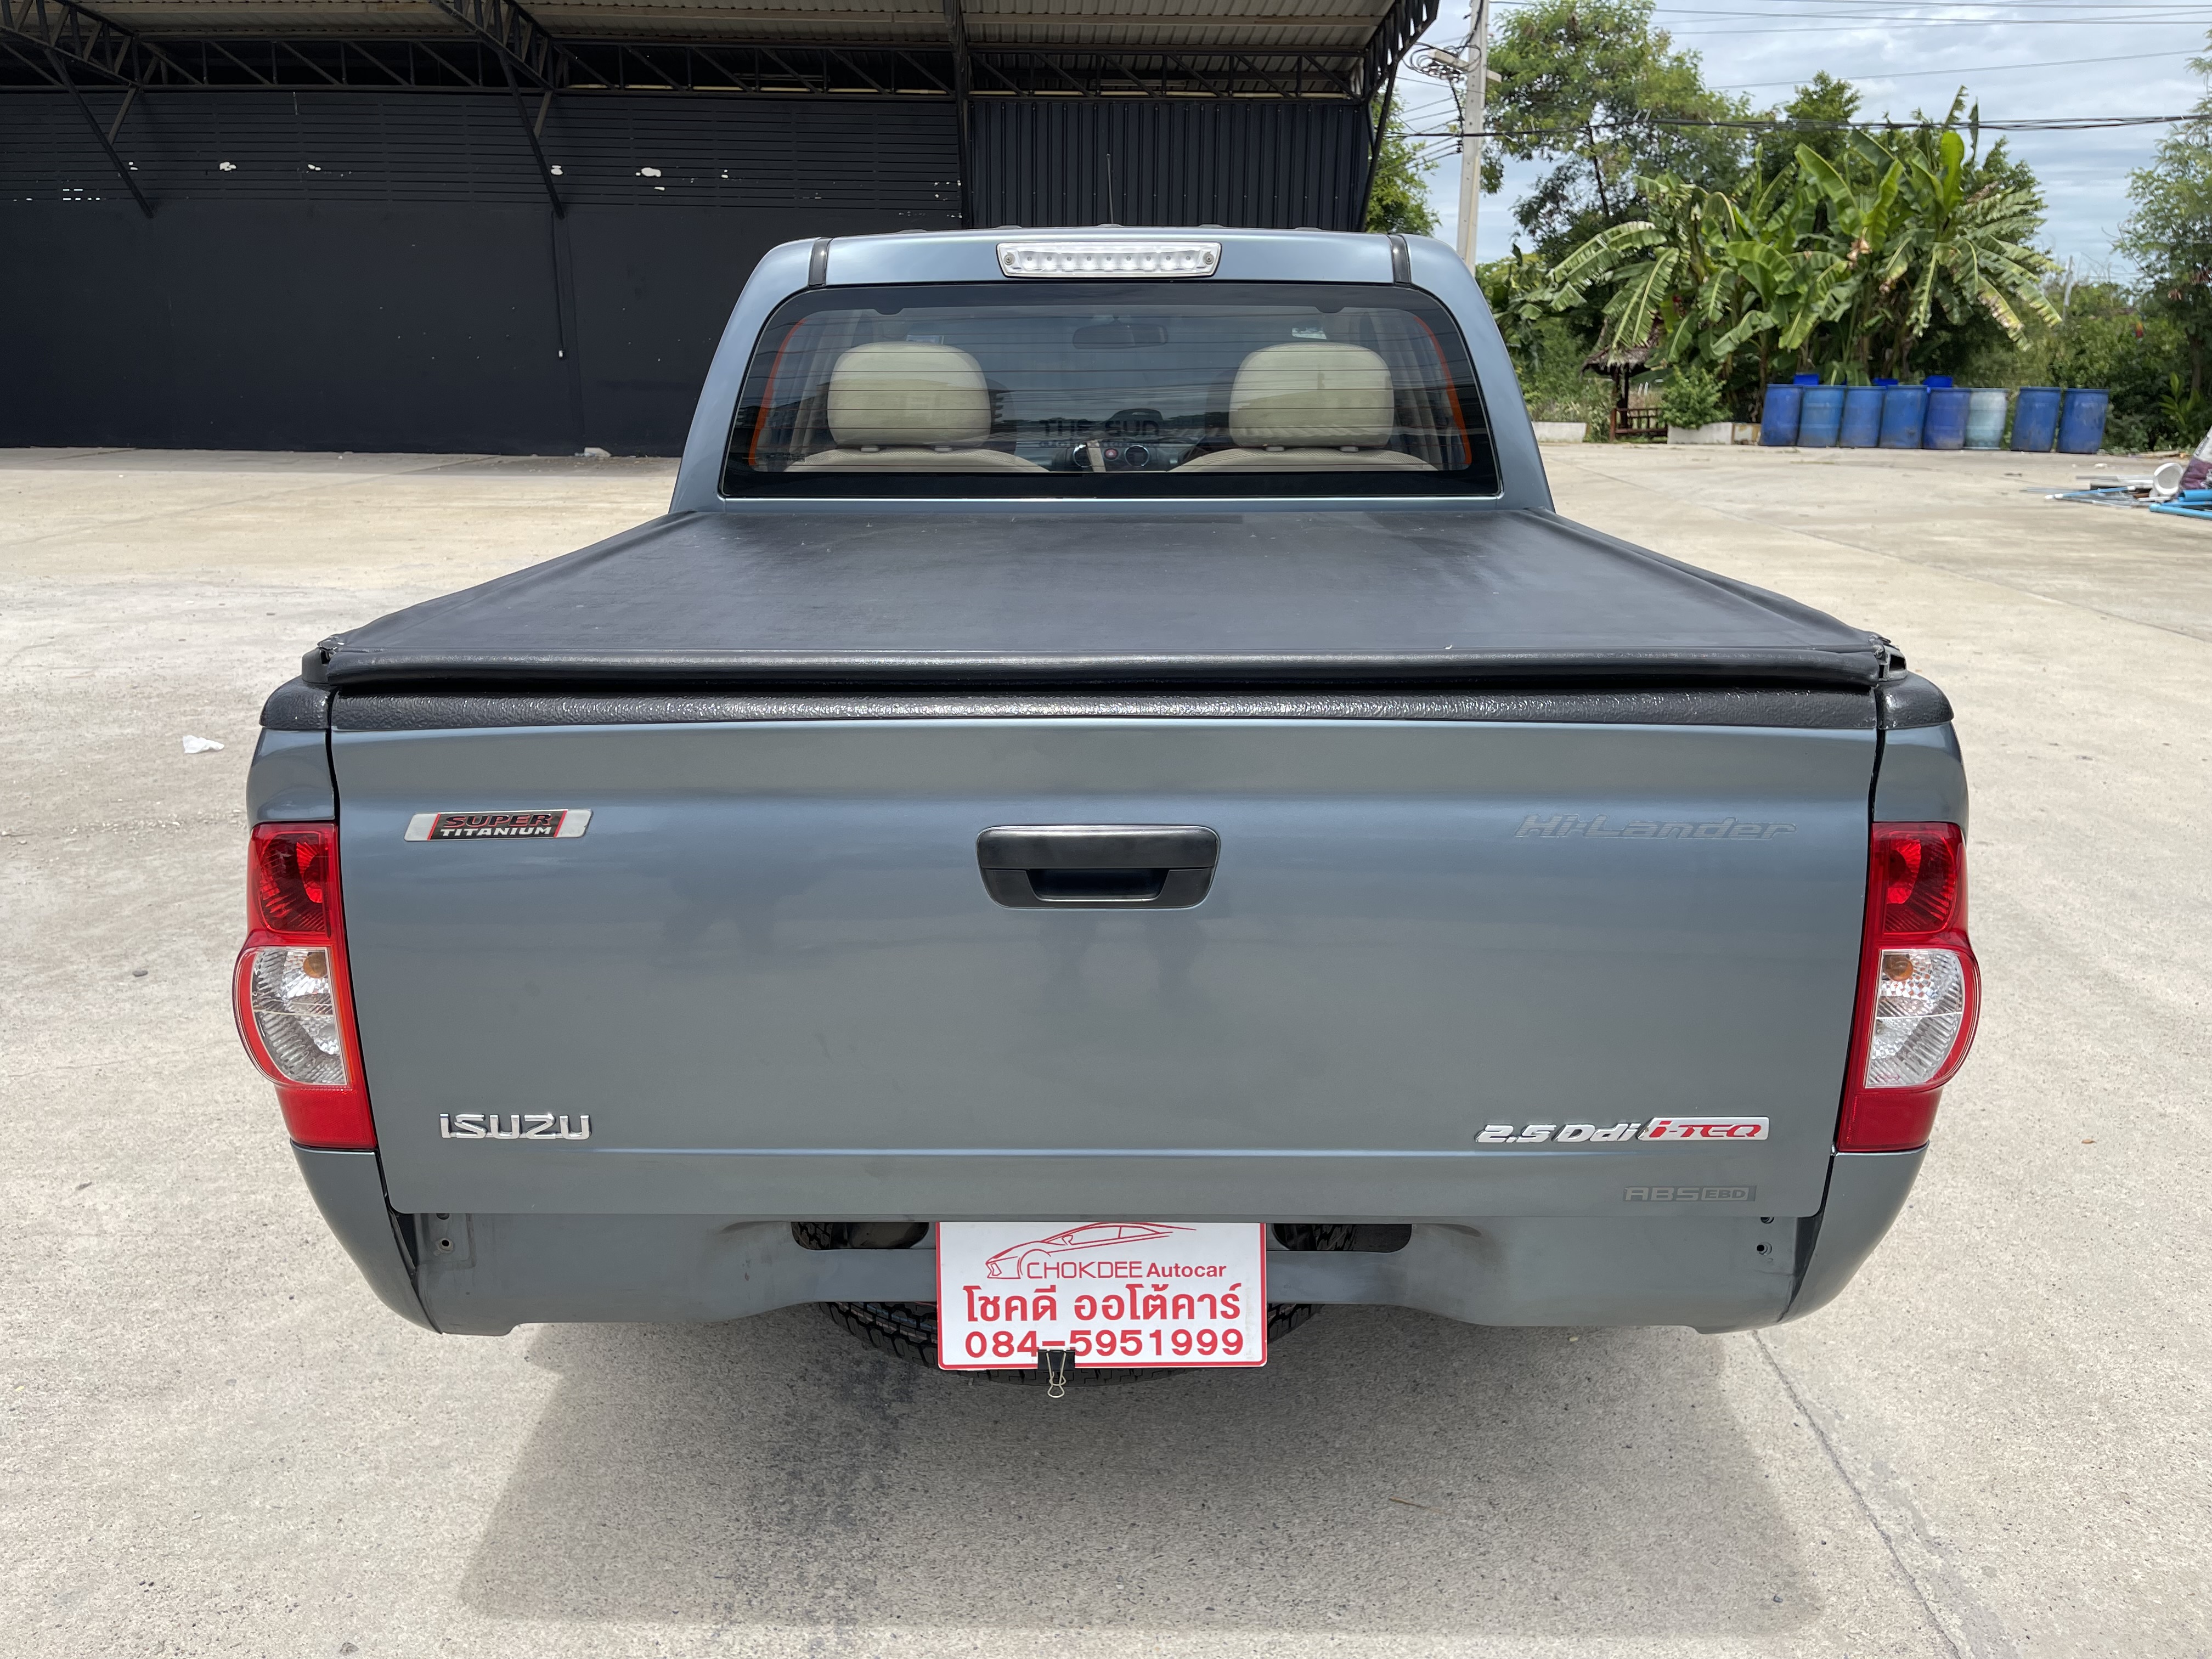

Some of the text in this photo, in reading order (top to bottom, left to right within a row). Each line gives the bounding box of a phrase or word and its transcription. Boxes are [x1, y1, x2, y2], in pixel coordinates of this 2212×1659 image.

[443, 814, 552, 828] SUPER
[440, 827, 551, 837] TITANIUM
[440, 1113, 592, 1139] ISUZU
[1625, 1187, 1746, 1201] ABS EBD
[1027, 1261, 1227, 1279] CHOKDEE Autocar
[963, 1283, 1242, 1322] โชคดี ออโต้คาร์
[965, 1329, 1244, 1358] 084-5951999
